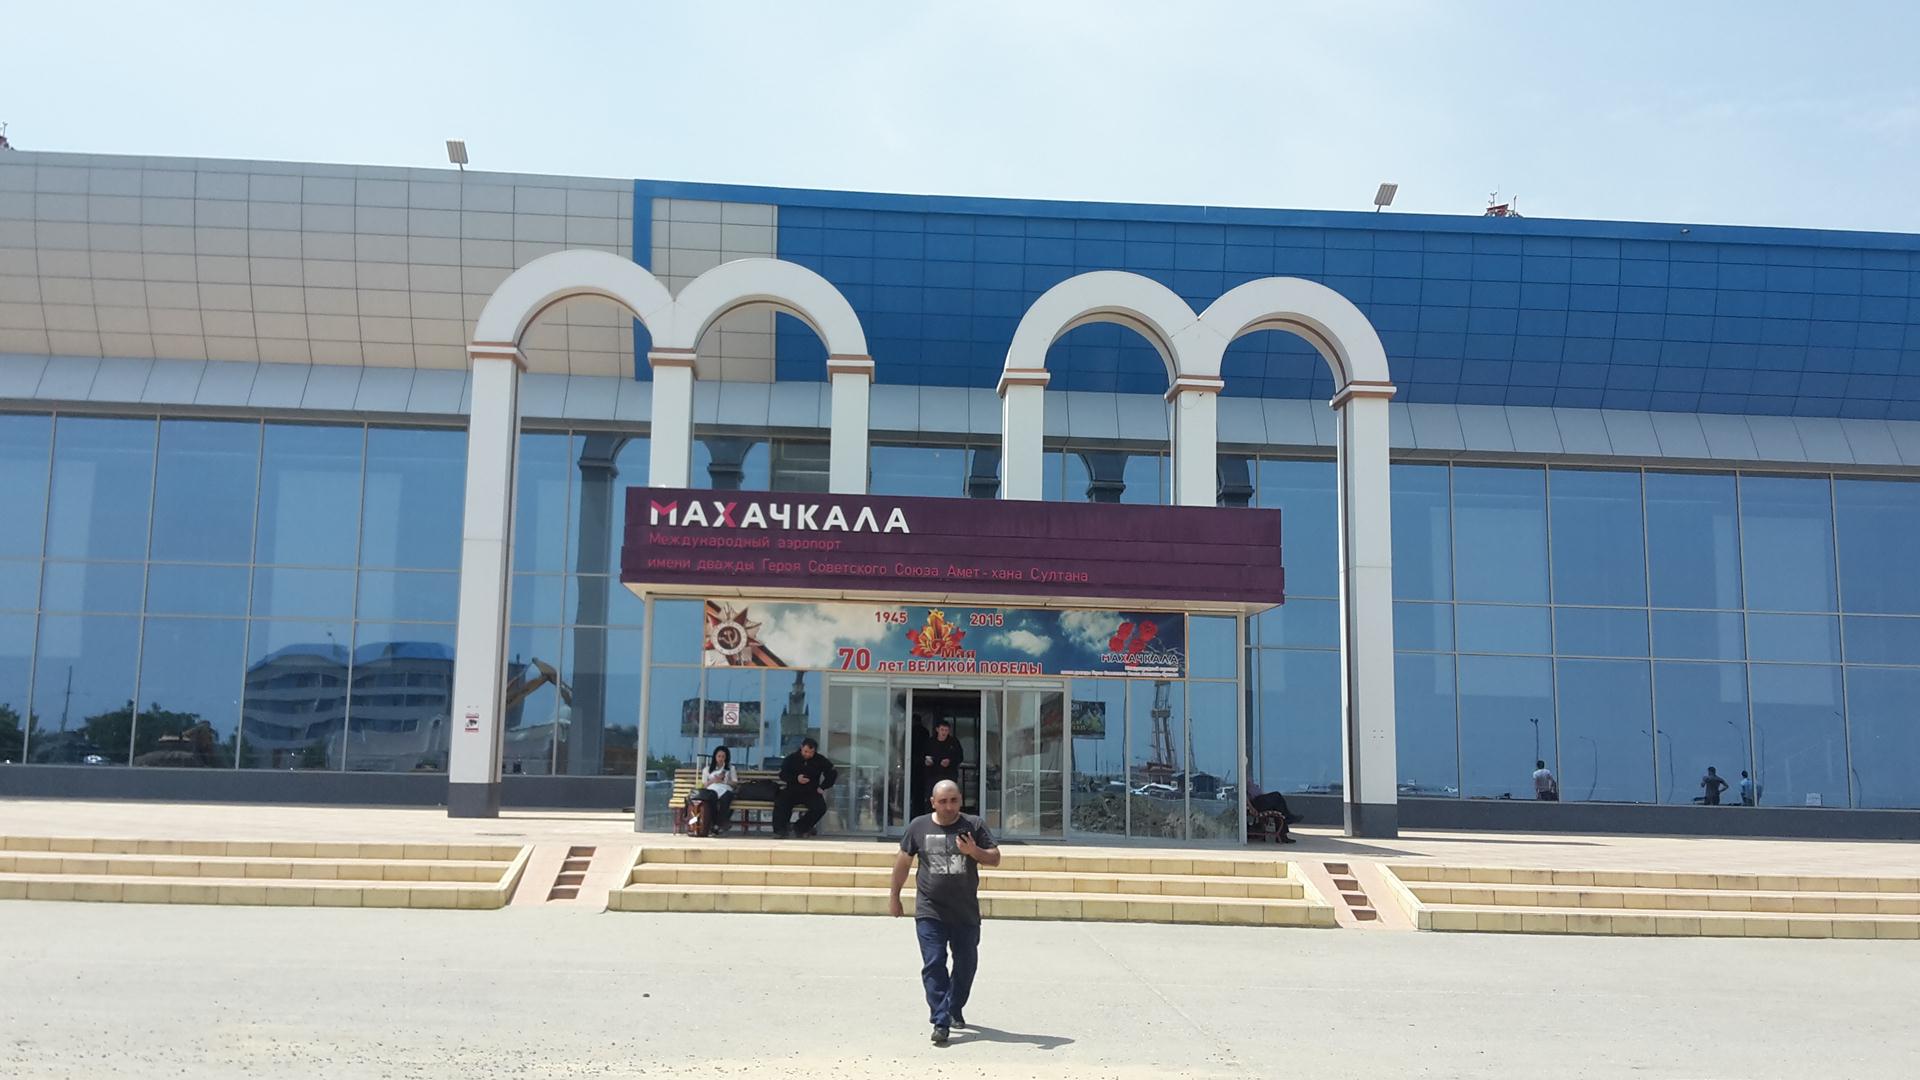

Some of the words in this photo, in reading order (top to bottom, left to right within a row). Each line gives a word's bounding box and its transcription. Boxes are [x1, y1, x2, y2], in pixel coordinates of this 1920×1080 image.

[650, 500, 911, 533] МАХАЧКАЛА
[649, 534, 771, 549] Международный
[778, 537, 843, 551] аэропорт
[648, 558, 691, 569] имени
[696, 559, 755, 574] дважды
[762, 559, 801, 572] Героя
[808, 561, 888, 576] Советского
[895, 563, 940, 576] Союза
[1030, 567, 1089, 582] Султана
[874, 611, 909, 625] 1945
[969, 613, 1004, 627] 2015
[839, 648, 872, 672] 70
[878, 660, 905, 673] лет
[907, 658, 977, 674] ВЕЛИКОЙ
[981, 662, 1044, 675] ПОБЕДЫ
[1101, 653, 1179, 664] МАХАЧКАЛА
